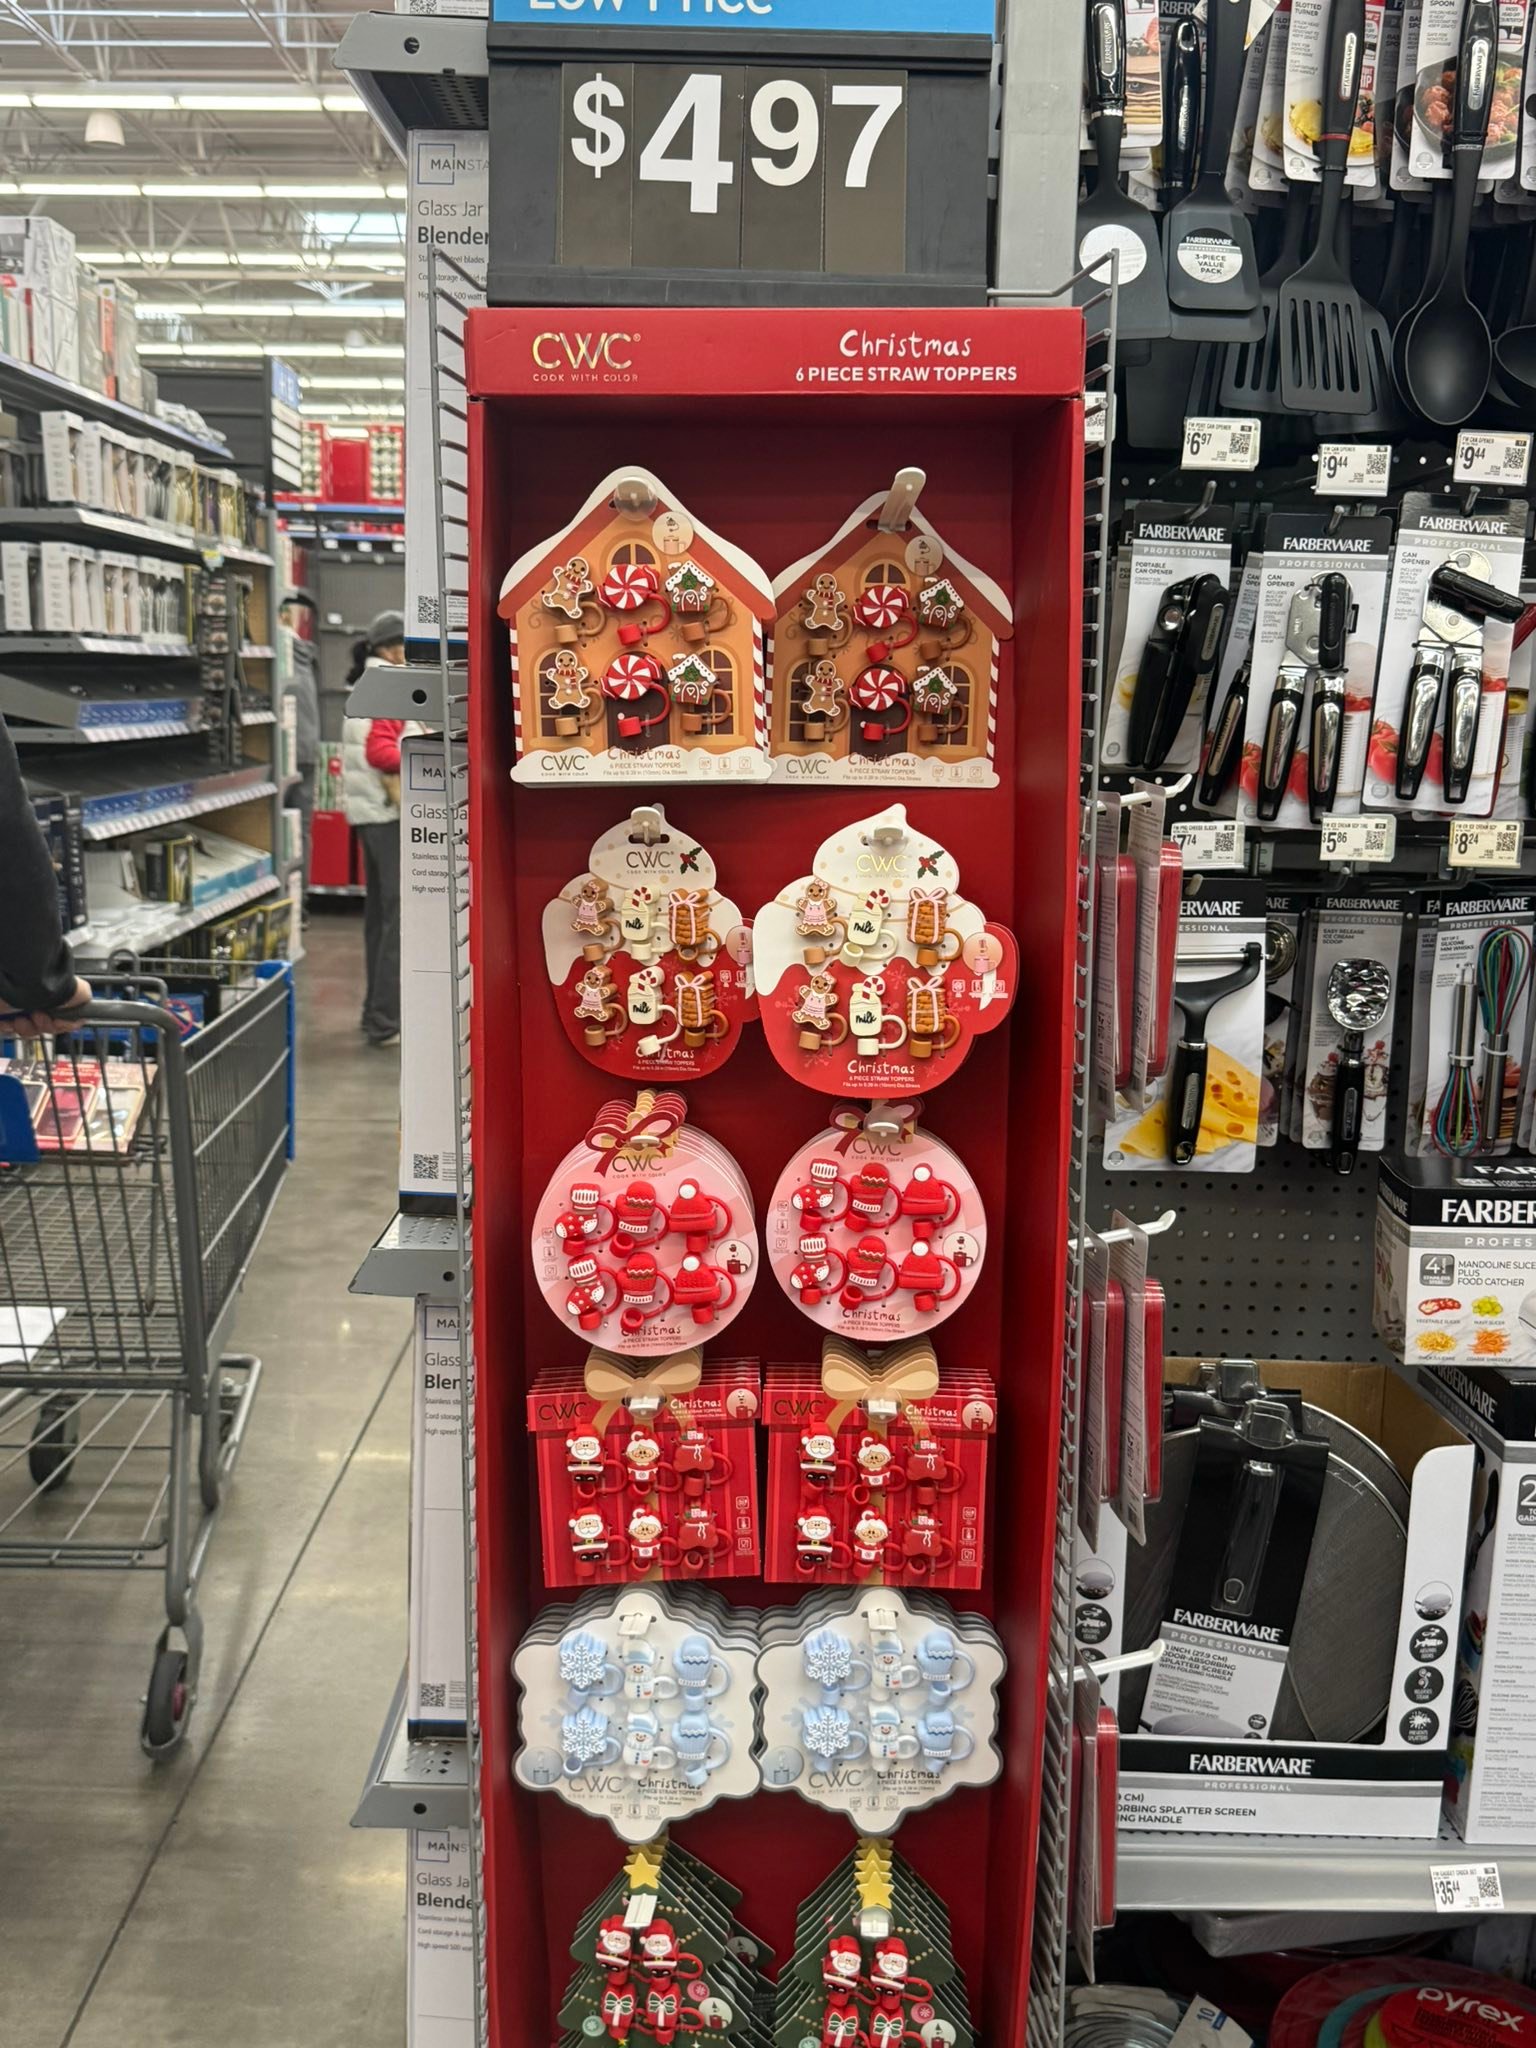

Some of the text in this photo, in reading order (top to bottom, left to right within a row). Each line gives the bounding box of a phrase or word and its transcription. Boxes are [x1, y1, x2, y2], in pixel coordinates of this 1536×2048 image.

[1295, 2, 1322, 10] SLOTTED
[418, 200, 484, 217] Glass Jar
[839, 330, 972, 358] Christmas
[532, 373, 639, 382] COOK WITH COLOR
[796, 366, 1018, 381] 6 PIECE STRAW TOPPERS
[1419, 516, 1508, 534] FARBERWARE
[1138, 524, 1225, 541] FARBERWARE
[1283, 537, 1372, 552] FARBERWARE
[1414, 538, 1503, 551] PROFESSIONAL
[1144, 547, 1217, 557] PROFESSIONAL
[1280, 560, 1366, 569] PROFESSIONAL
[607, 746, 681, 761] Christmas
[848, 752, 917, 767] Christmas
[1327, 898, 1400, 910] FARBERWARE
[1446, 897, 1529, 916] FARBERWARE
[854, 920, 875, 934] milk
[1450, 919, 1517, 929] PROFESSIONAL
[633, 1002, 651, 1013] milk
[856, 1011, 877, 1024] milk
[847, 1060, 915, 1074] Christmas
[612, 1154, 662, 1172] CWC
[1458, 1261, 1511, 1269] MANDOLINE
[1458, 1269, 1480, 1277] PLUS
[1458, 1278, 1524, 1286] FOOD CATCHER
[670, 1398, 721, 1409] Christmas
[906, 1404, 957, 1417] Christmas
[1172, 1608, 1280, 1642] FARBERWARE
[1170, 1631, 1274, 1659] PROFESSIONAL
[1170, 1646, 1191, 1654] INCH
[1160, 1657, 1234, 1677] SPLATTER SCREEN
[1189, 1754, 1312, 1775] FARBERWARE
[1204, 1781, 1292, 1792] PROFESSIONAL
[1159, 1806, 1212, 1815] SPLATTER
[1214, 1808, 1256, 1817] SCREEN
[1138, 1815, 1182, 1824] HANDLE
[417, 1872, 452, 1887] Glass
[1416, 1987, 1524, 2033] pyrex
